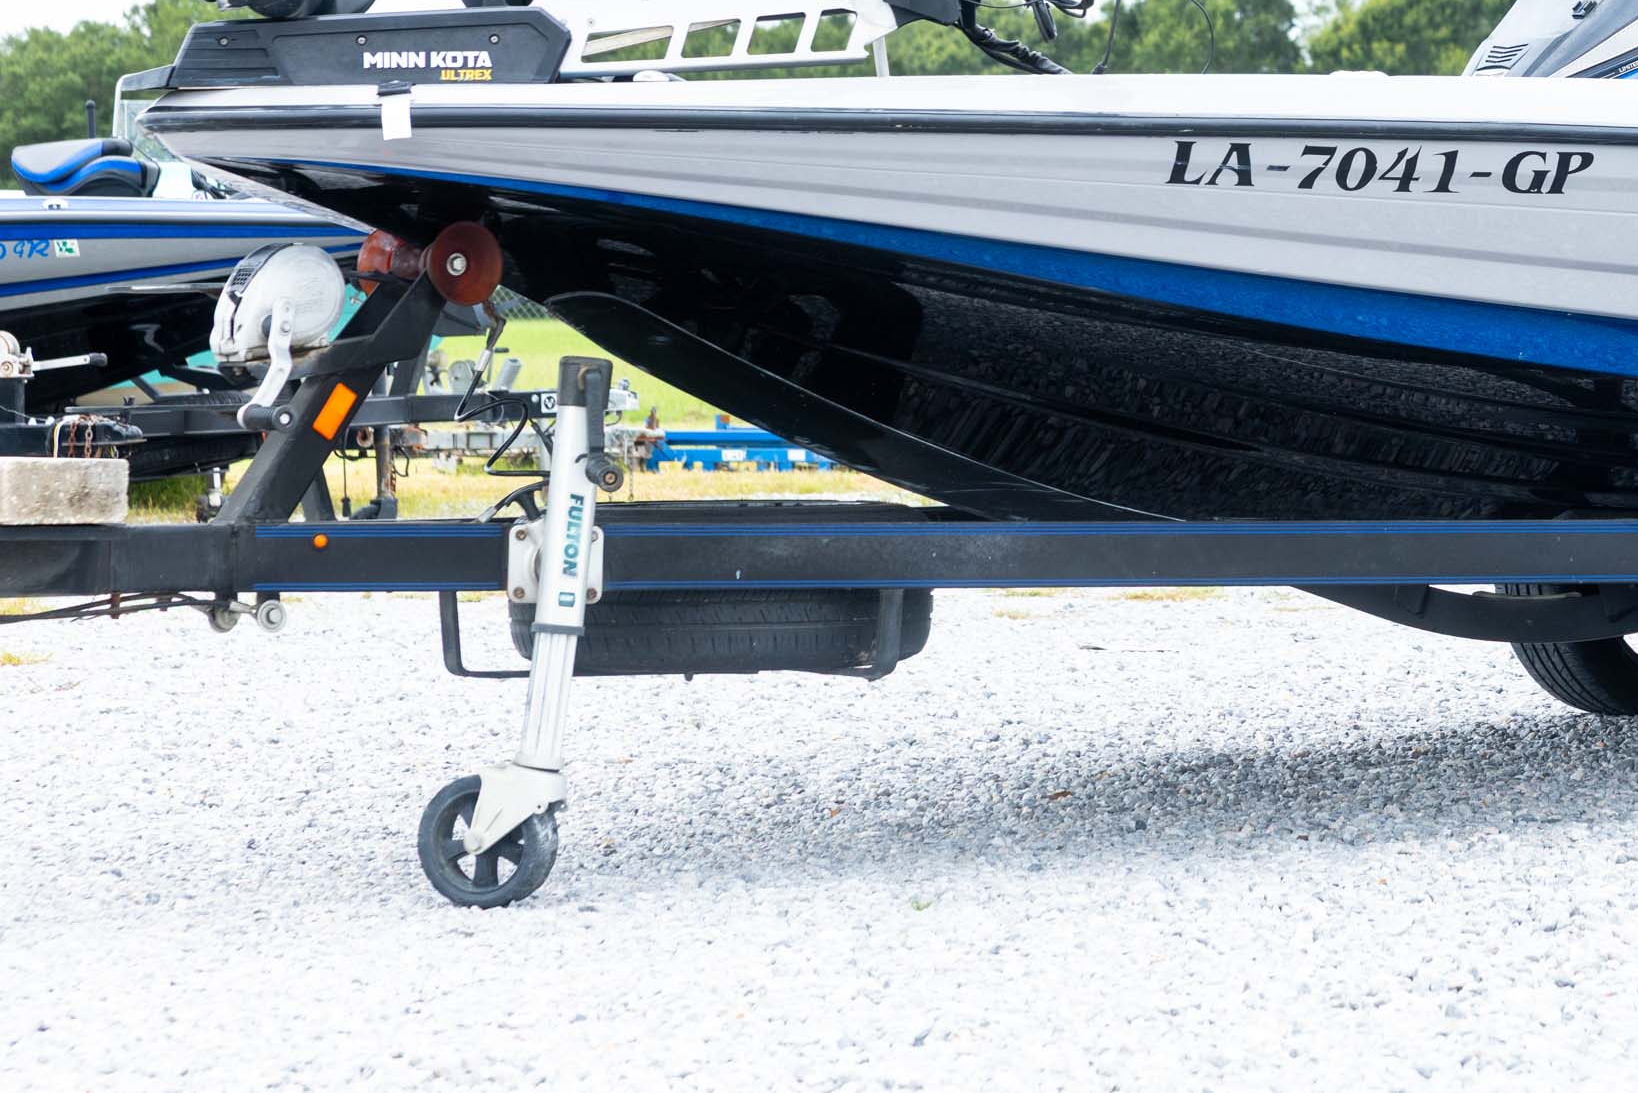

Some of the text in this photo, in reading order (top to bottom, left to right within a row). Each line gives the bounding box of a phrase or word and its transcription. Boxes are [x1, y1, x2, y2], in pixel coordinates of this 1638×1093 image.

[363, 51, 493, 69] MINN KOTA
[440, 69, 493, 81] ULTREX
[562, 493, 584, 578] FULTON
